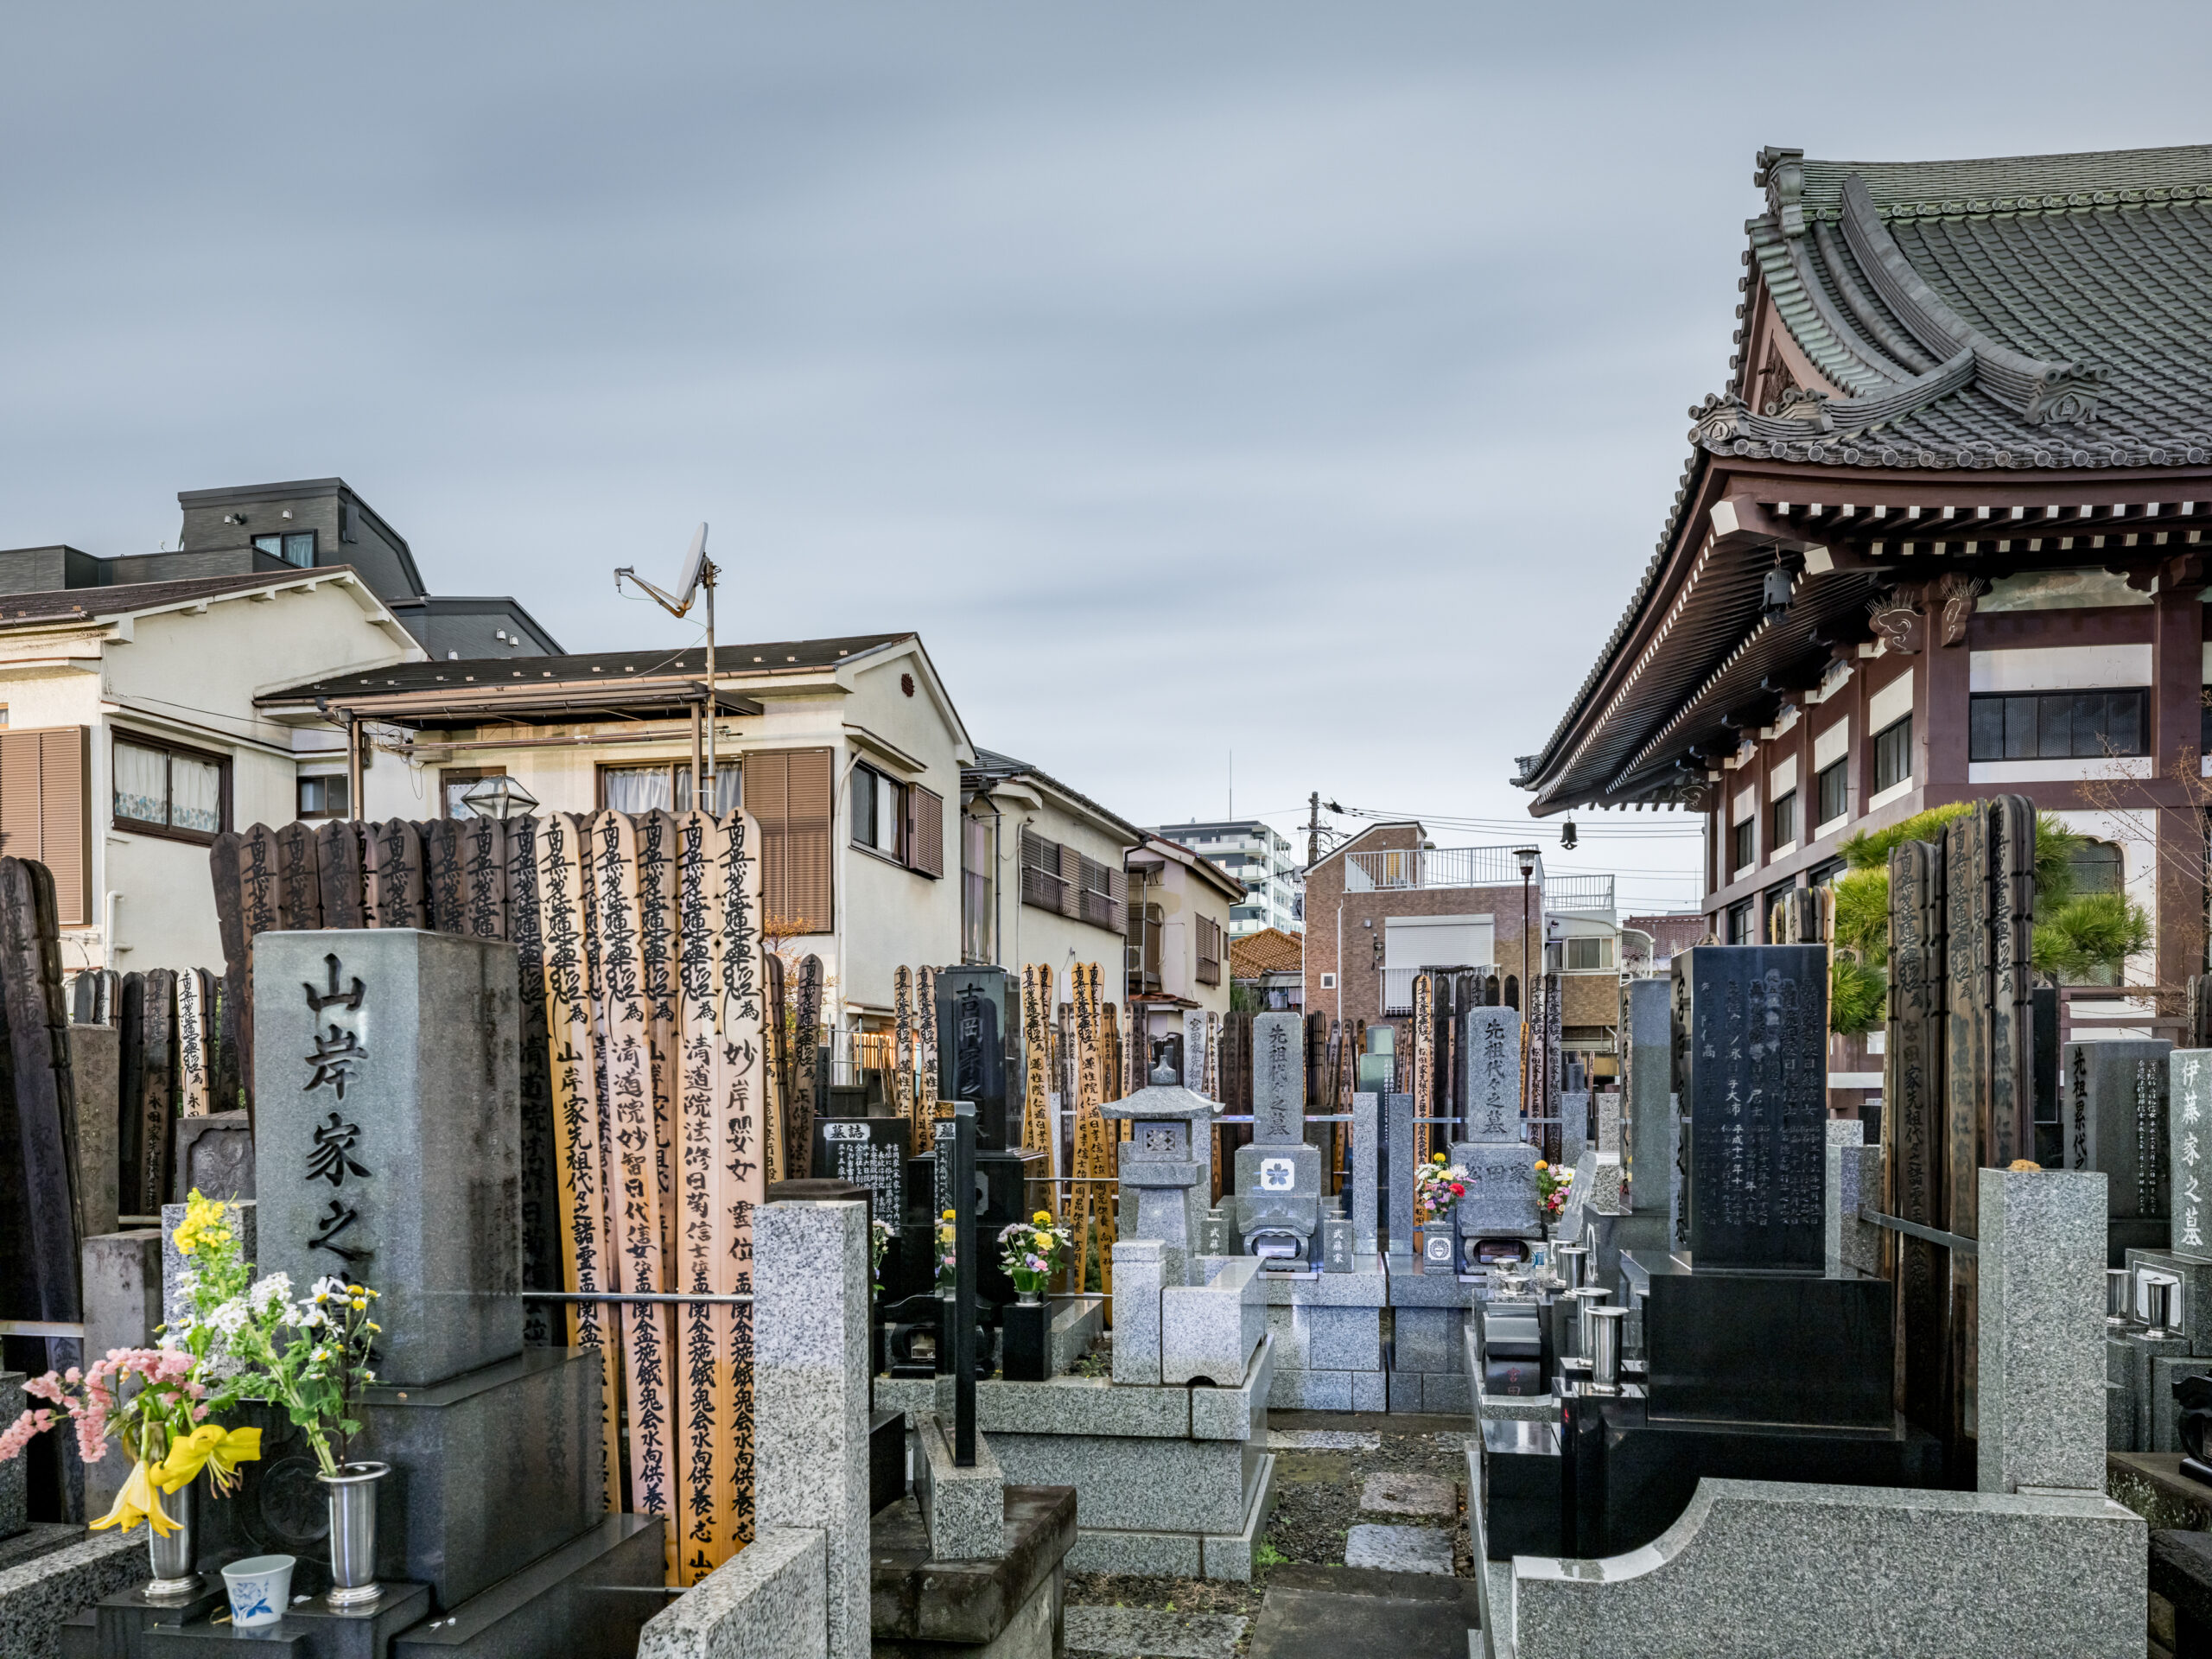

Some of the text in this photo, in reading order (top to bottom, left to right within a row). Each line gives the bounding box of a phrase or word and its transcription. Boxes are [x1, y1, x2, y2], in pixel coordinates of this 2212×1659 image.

[956, 982, 990, 1139] 吉岡家之
[1268, 1023, 1290, 1136] 先祖代々之墓
[1482, 1018, 1507, 1135] 先祖代々之墓
[830, 1124, 865, 1139] 墓誌
[2181, 1057, 2204, 1247] 伊藤家之墓
